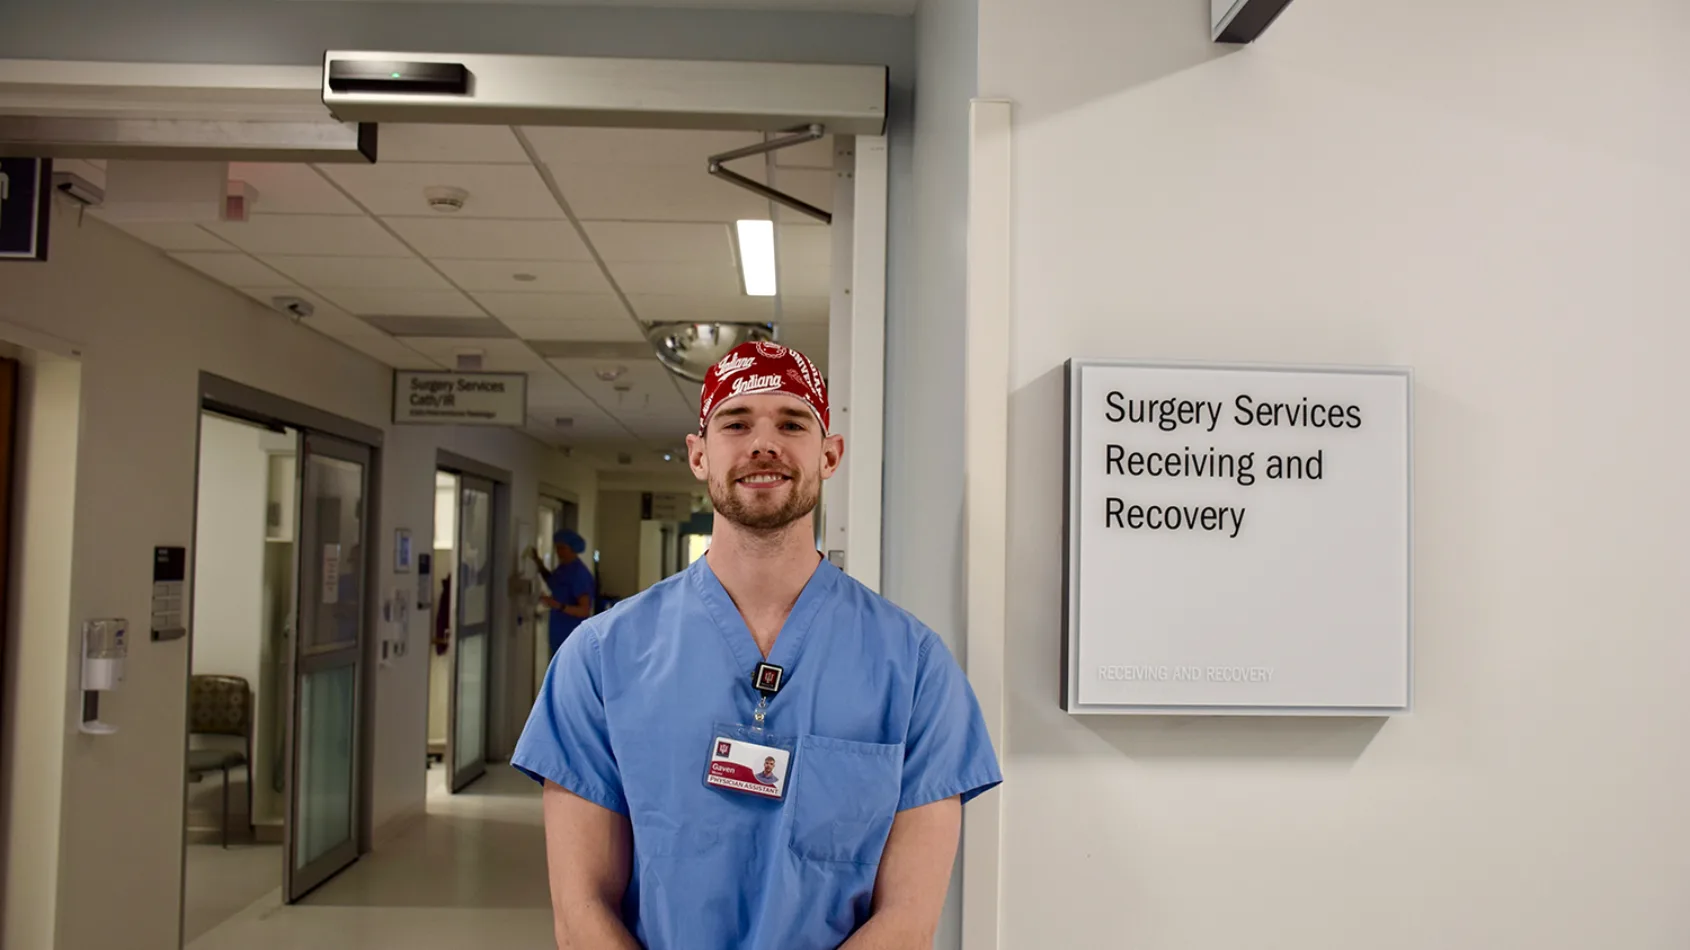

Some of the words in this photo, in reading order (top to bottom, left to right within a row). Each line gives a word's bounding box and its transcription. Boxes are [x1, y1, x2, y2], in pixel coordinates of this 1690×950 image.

[410, 377, 455, 393] Surgery
[457, 378, 505, 393] Services
[729, 374, 783, 397] Indiana
[409, 393, 455, 407] Cath/IR
[1105, 390, 1223, 432] Surgery
[1233, 394, 1363, 428] Services
[1105, 444, 1256, 486] Receiving
[1265, 449, 1324, 480] and
[1105, 497, 1246, 538] Recovery
[1098, 665, 1168, 682] RECEIVING
[1172, 666, 1201, 682] AND
[1205, 666, 1275, 683] RECOVERY
[712, 763, 736, 774] Gaven
[709, 776, 743, 788] PHYSICIAN
[743, 783, 779, 794] ASSISTANT
